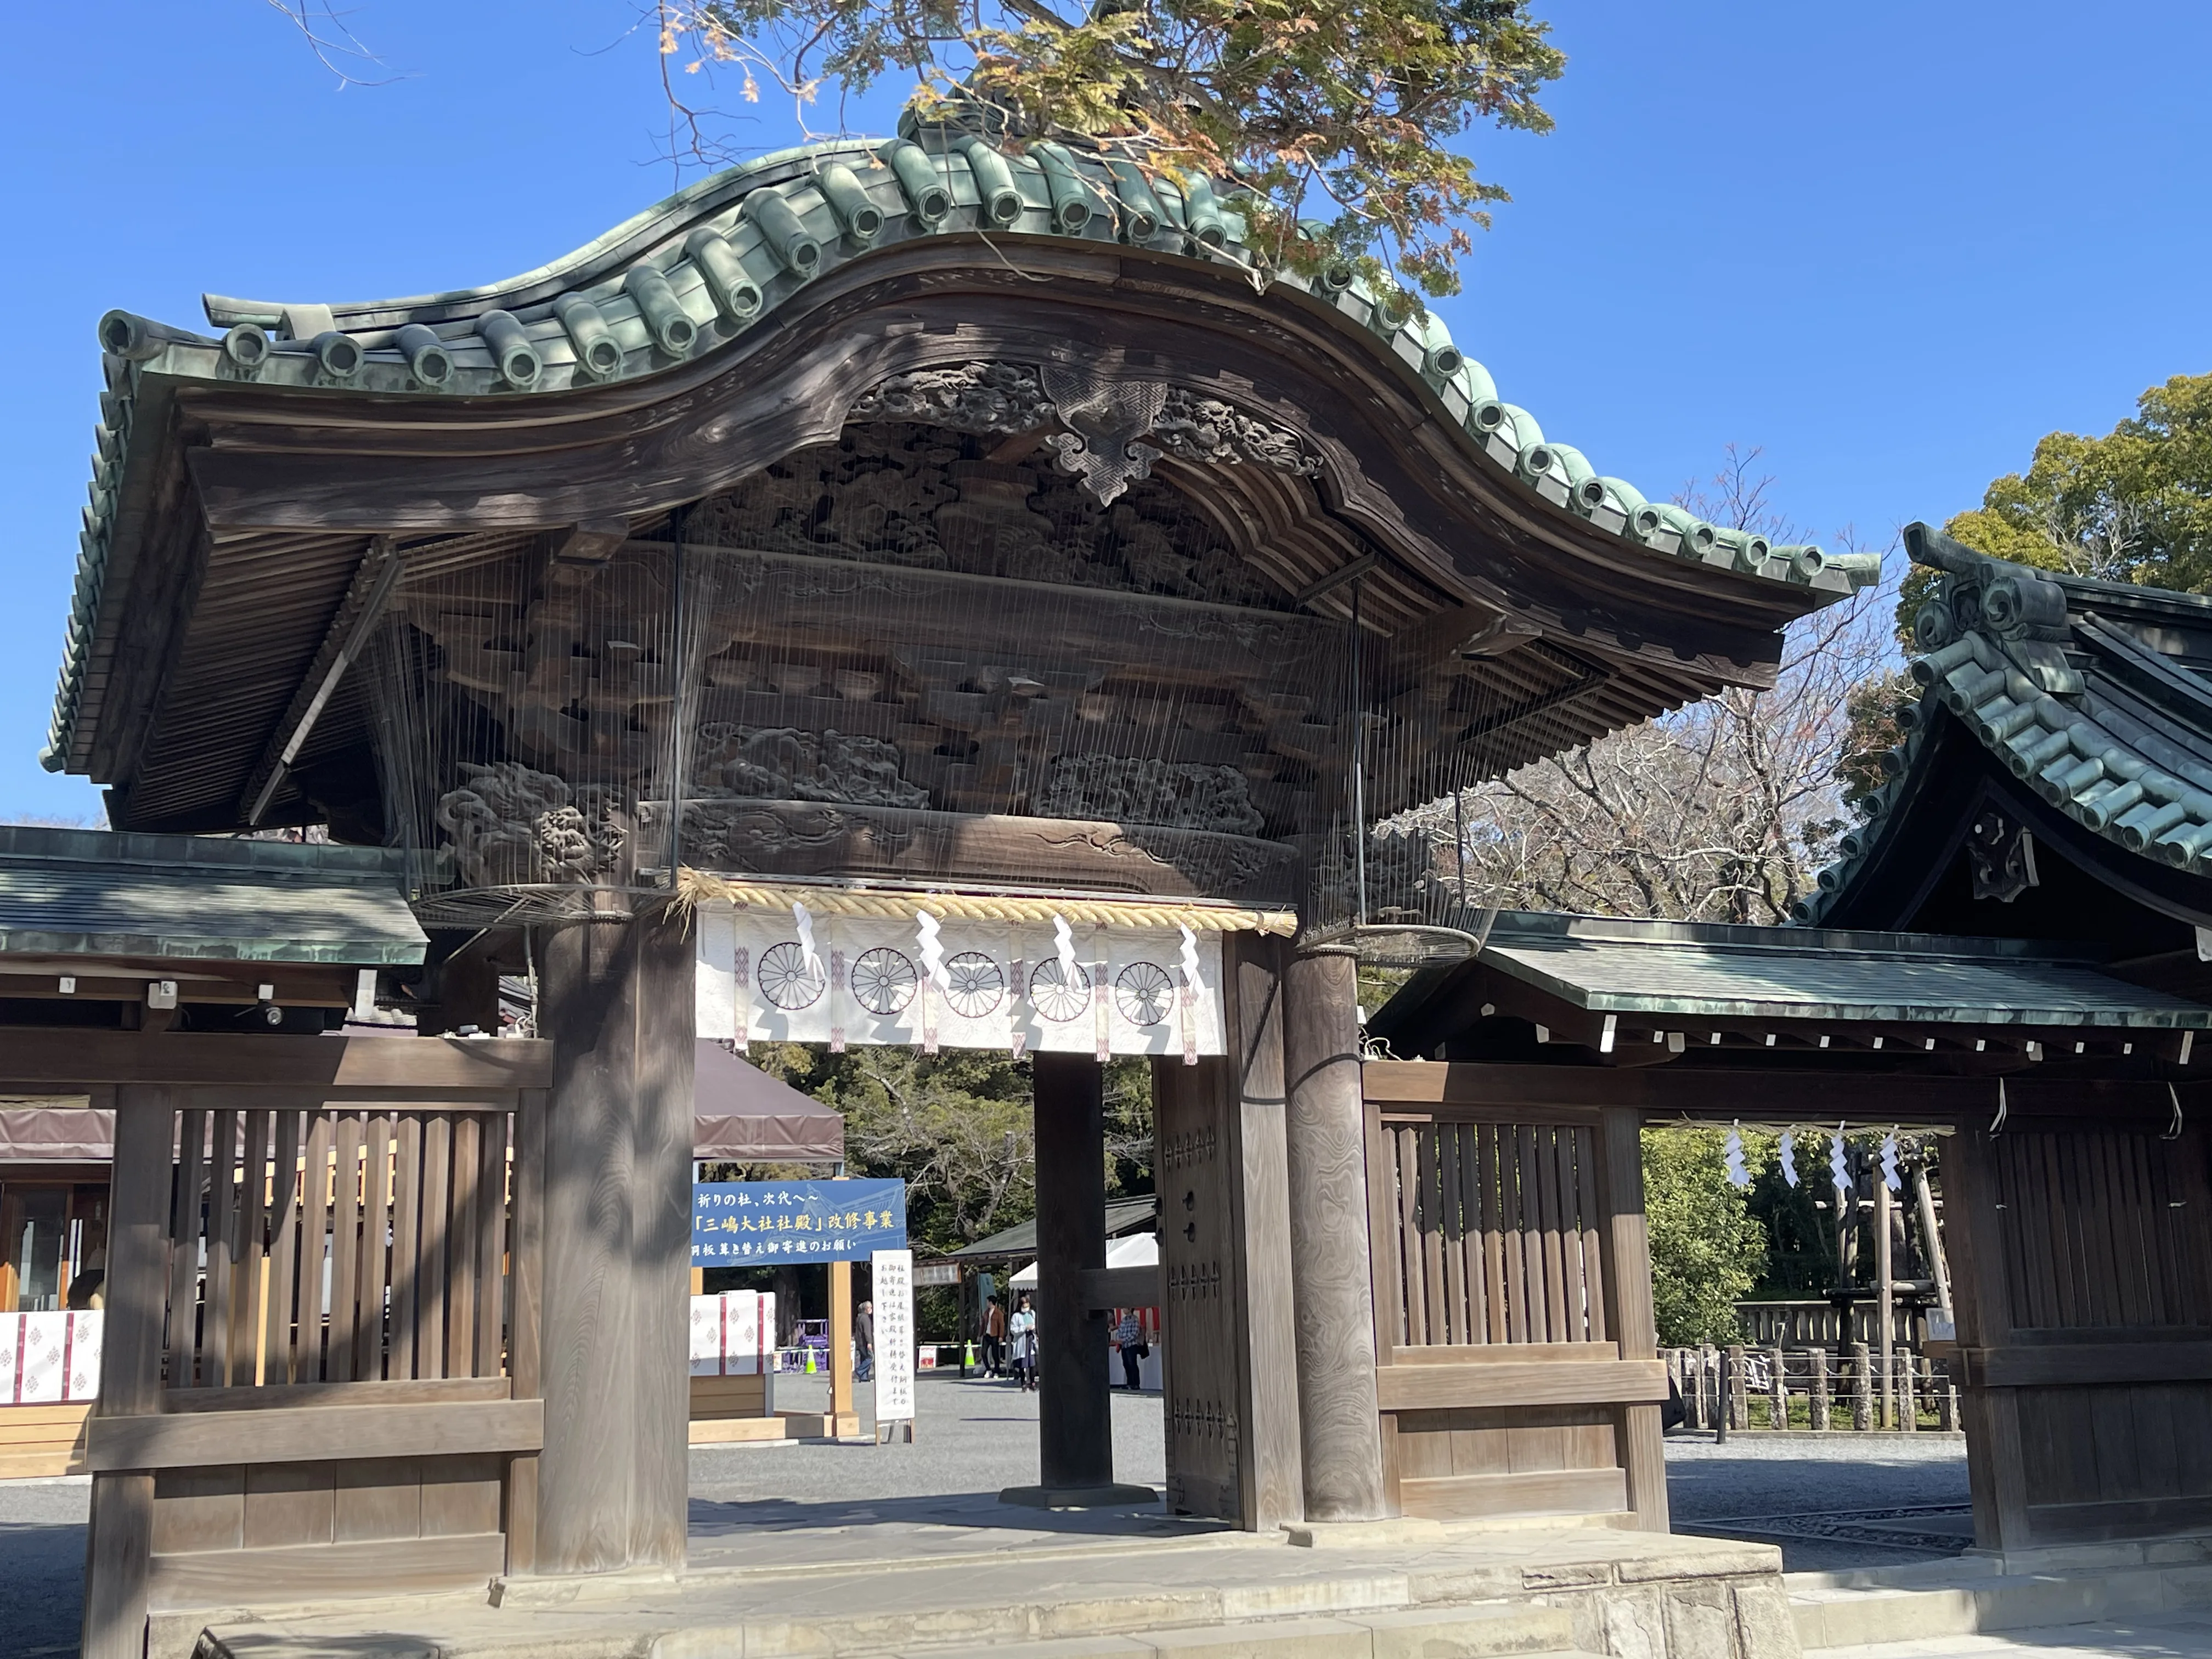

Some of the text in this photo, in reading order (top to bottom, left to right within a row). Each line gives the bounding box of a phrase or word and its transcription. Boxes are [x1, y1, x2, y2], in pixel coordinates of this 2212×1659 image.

[696, 1210, 894, 1234] 「三嶋大社社殿」改修事業
